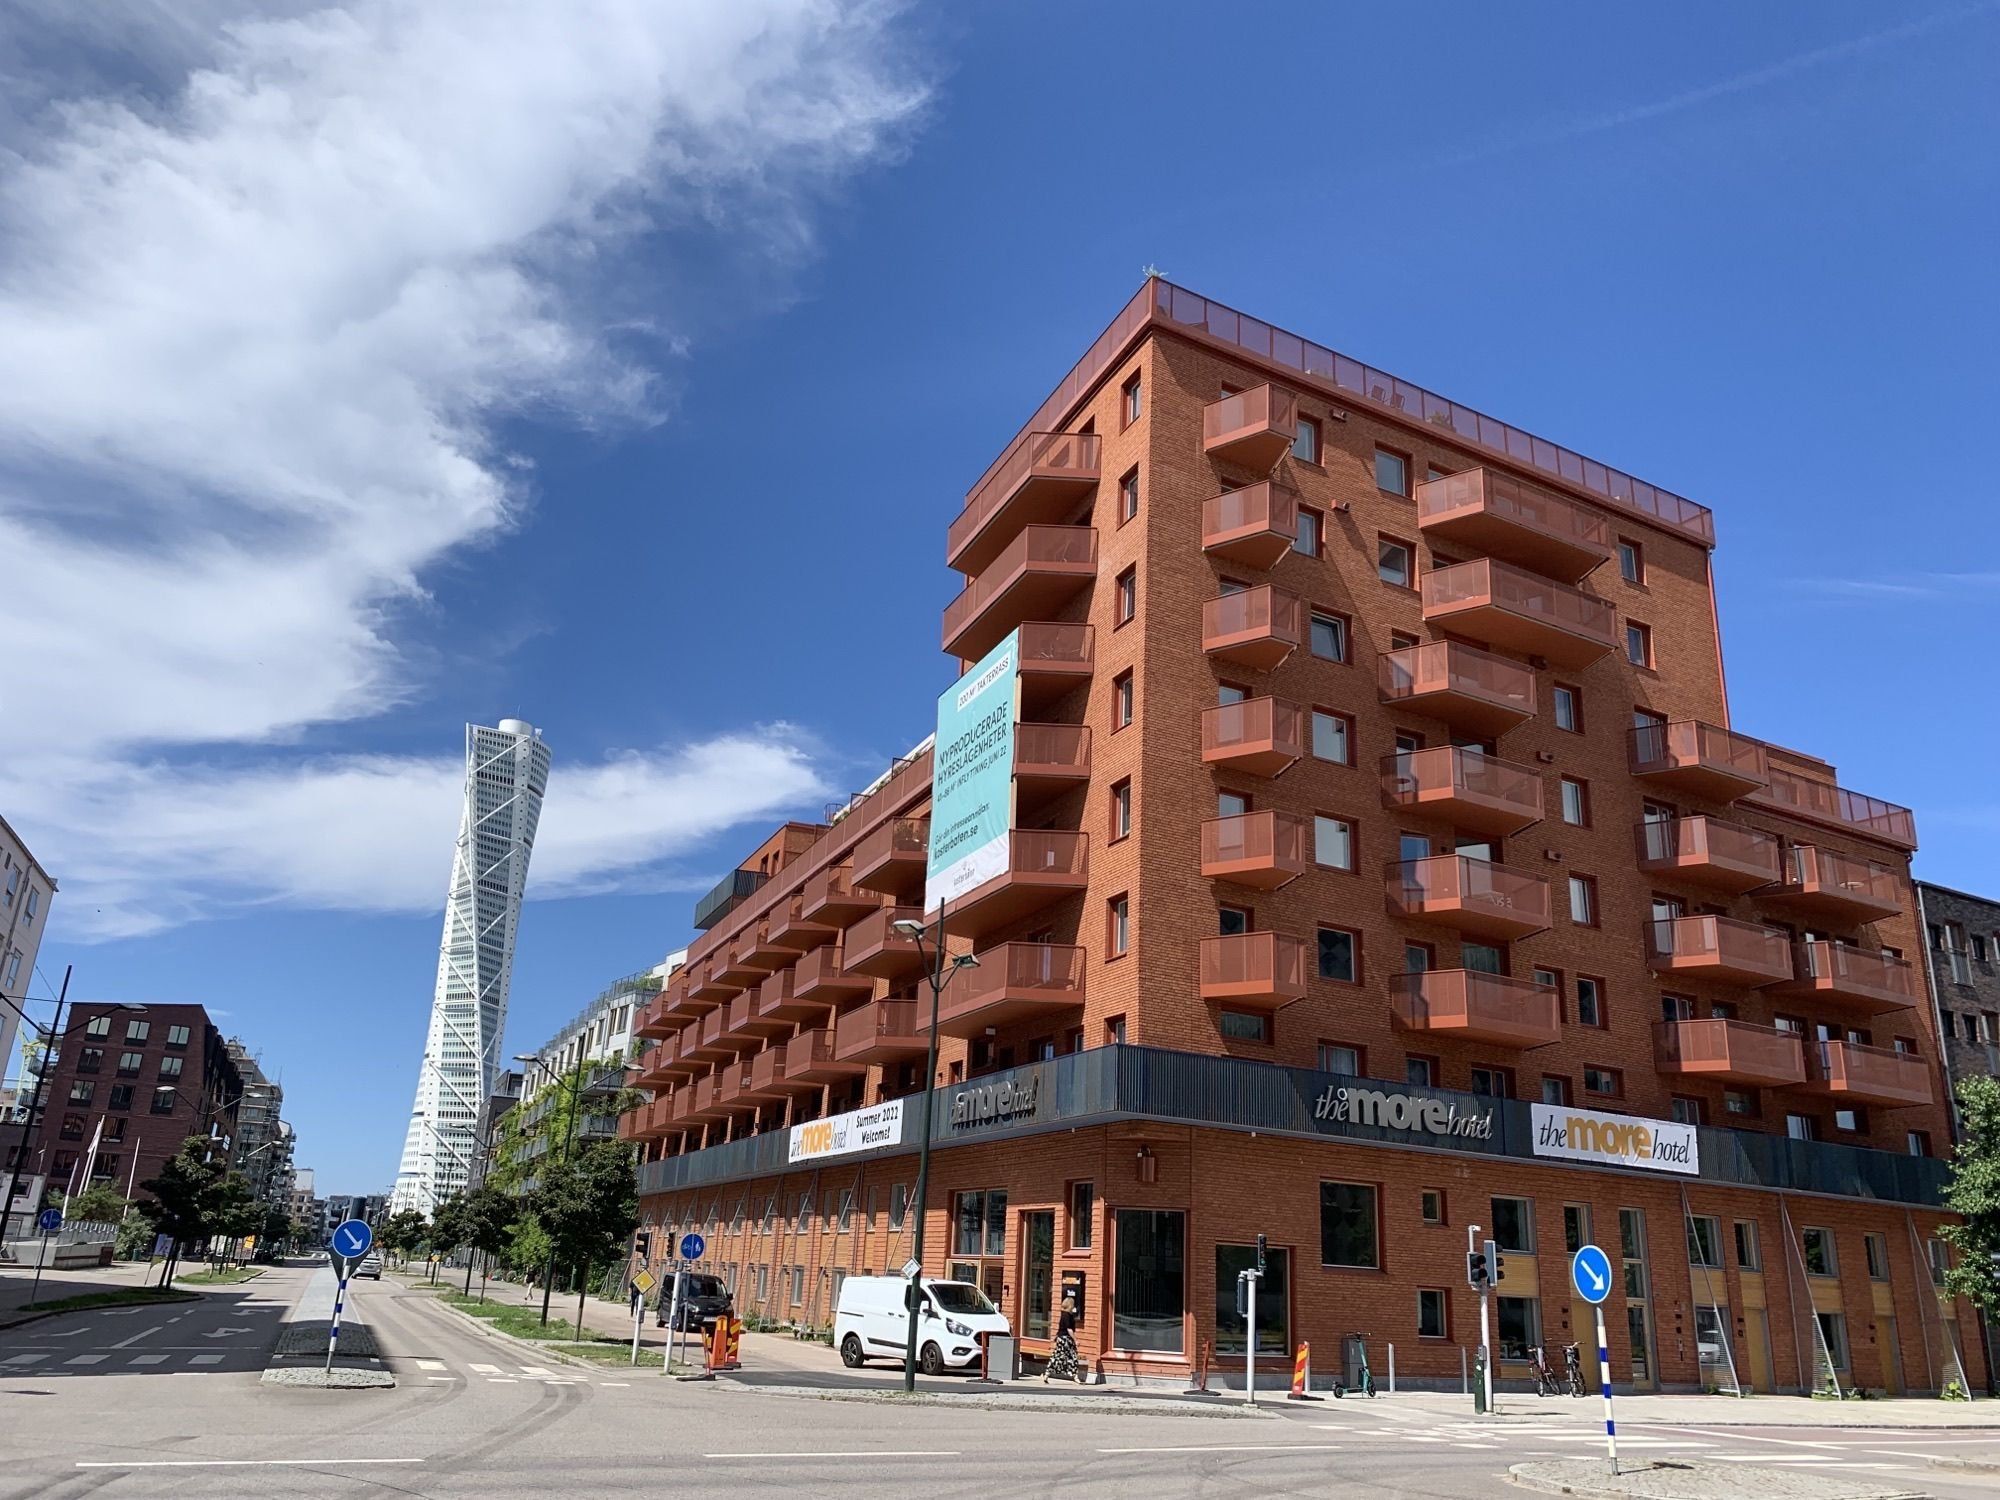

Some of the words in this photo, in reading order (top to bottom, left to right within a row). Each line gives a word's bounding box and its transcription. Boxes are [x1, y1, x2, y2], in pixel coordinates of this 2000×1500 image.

[977, 657, 1009, 693] TAKTERRASS
[937, 722, 1007, 786] HYRESLÄGENHETER
[939, 701, 1008, 768] NYPRODUCERADE
[957, 762, 988, 788] INFLYTTNING
[987, 752, 999, 770] JUNI
[999, 745, 1007, 759] 22
[856, 1111, 881, 1129] Summer
[882, 1106, 899, 1122] 2022
[964, 1081, 1011, 1120] more
[1316, 1085, 1349, 1122] the
[1349, 1087, 1448, 1135] more
[1447, 1103, 1494, 1141] hotel
[801, 1122, 833, 1155] more
[861, 1126, 891, 1145] Welcome!
[1540, 1115, 1567, 1148] the
[1566, 1115, 1652, 1159] more
[1652, 1127, 1690, 1164] hotel
